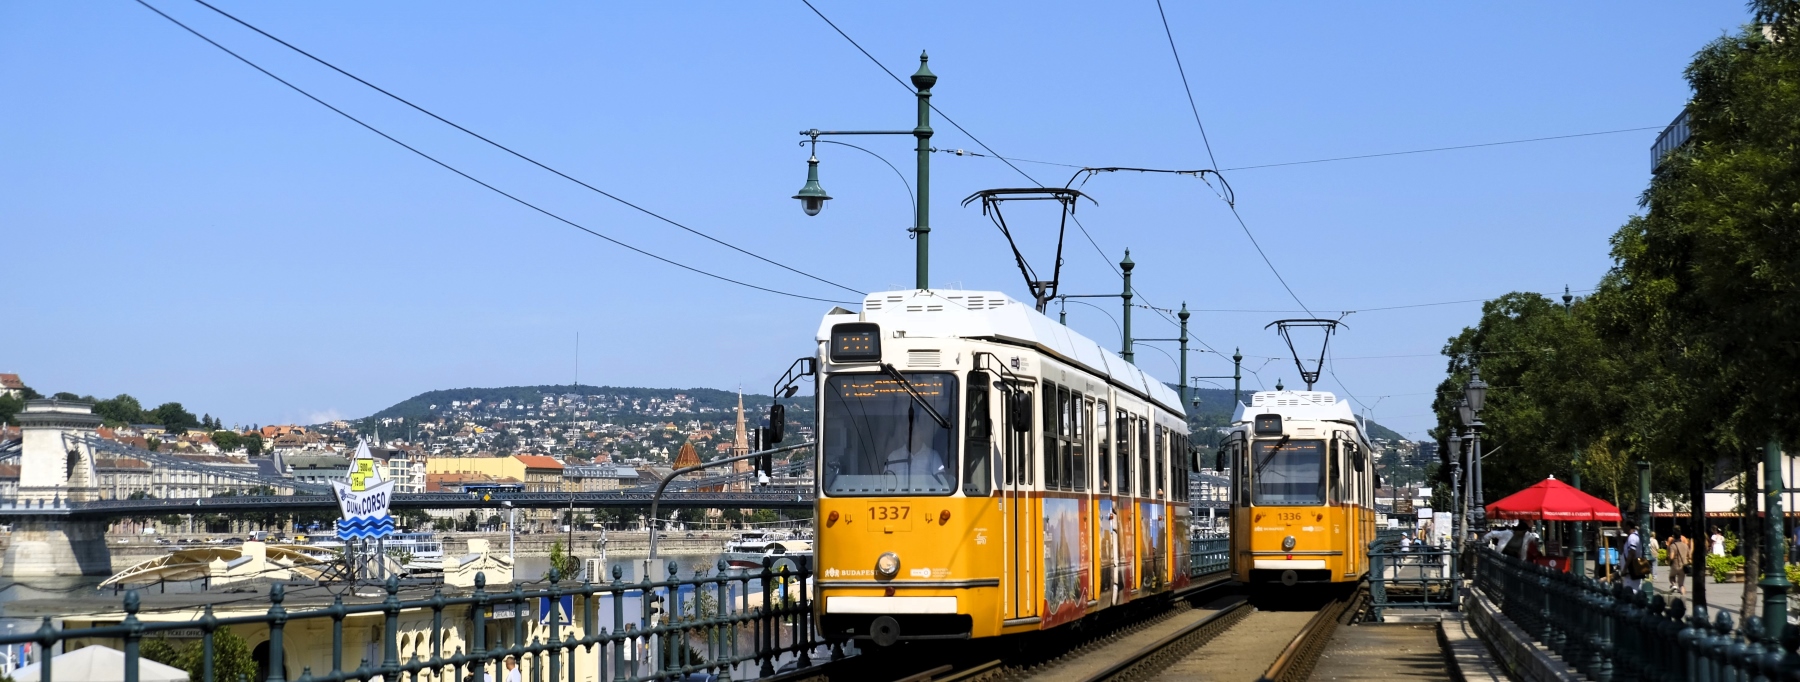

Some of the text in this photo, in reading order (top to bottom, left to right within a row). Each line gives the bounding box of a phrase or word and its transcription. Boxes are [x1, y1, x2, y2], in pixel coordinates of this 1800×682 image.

[346, 491, 386, 516] DUNA CORSO
[868, 506, 911, 520] 1337
[1277, 512, 1302, 521] 1336
